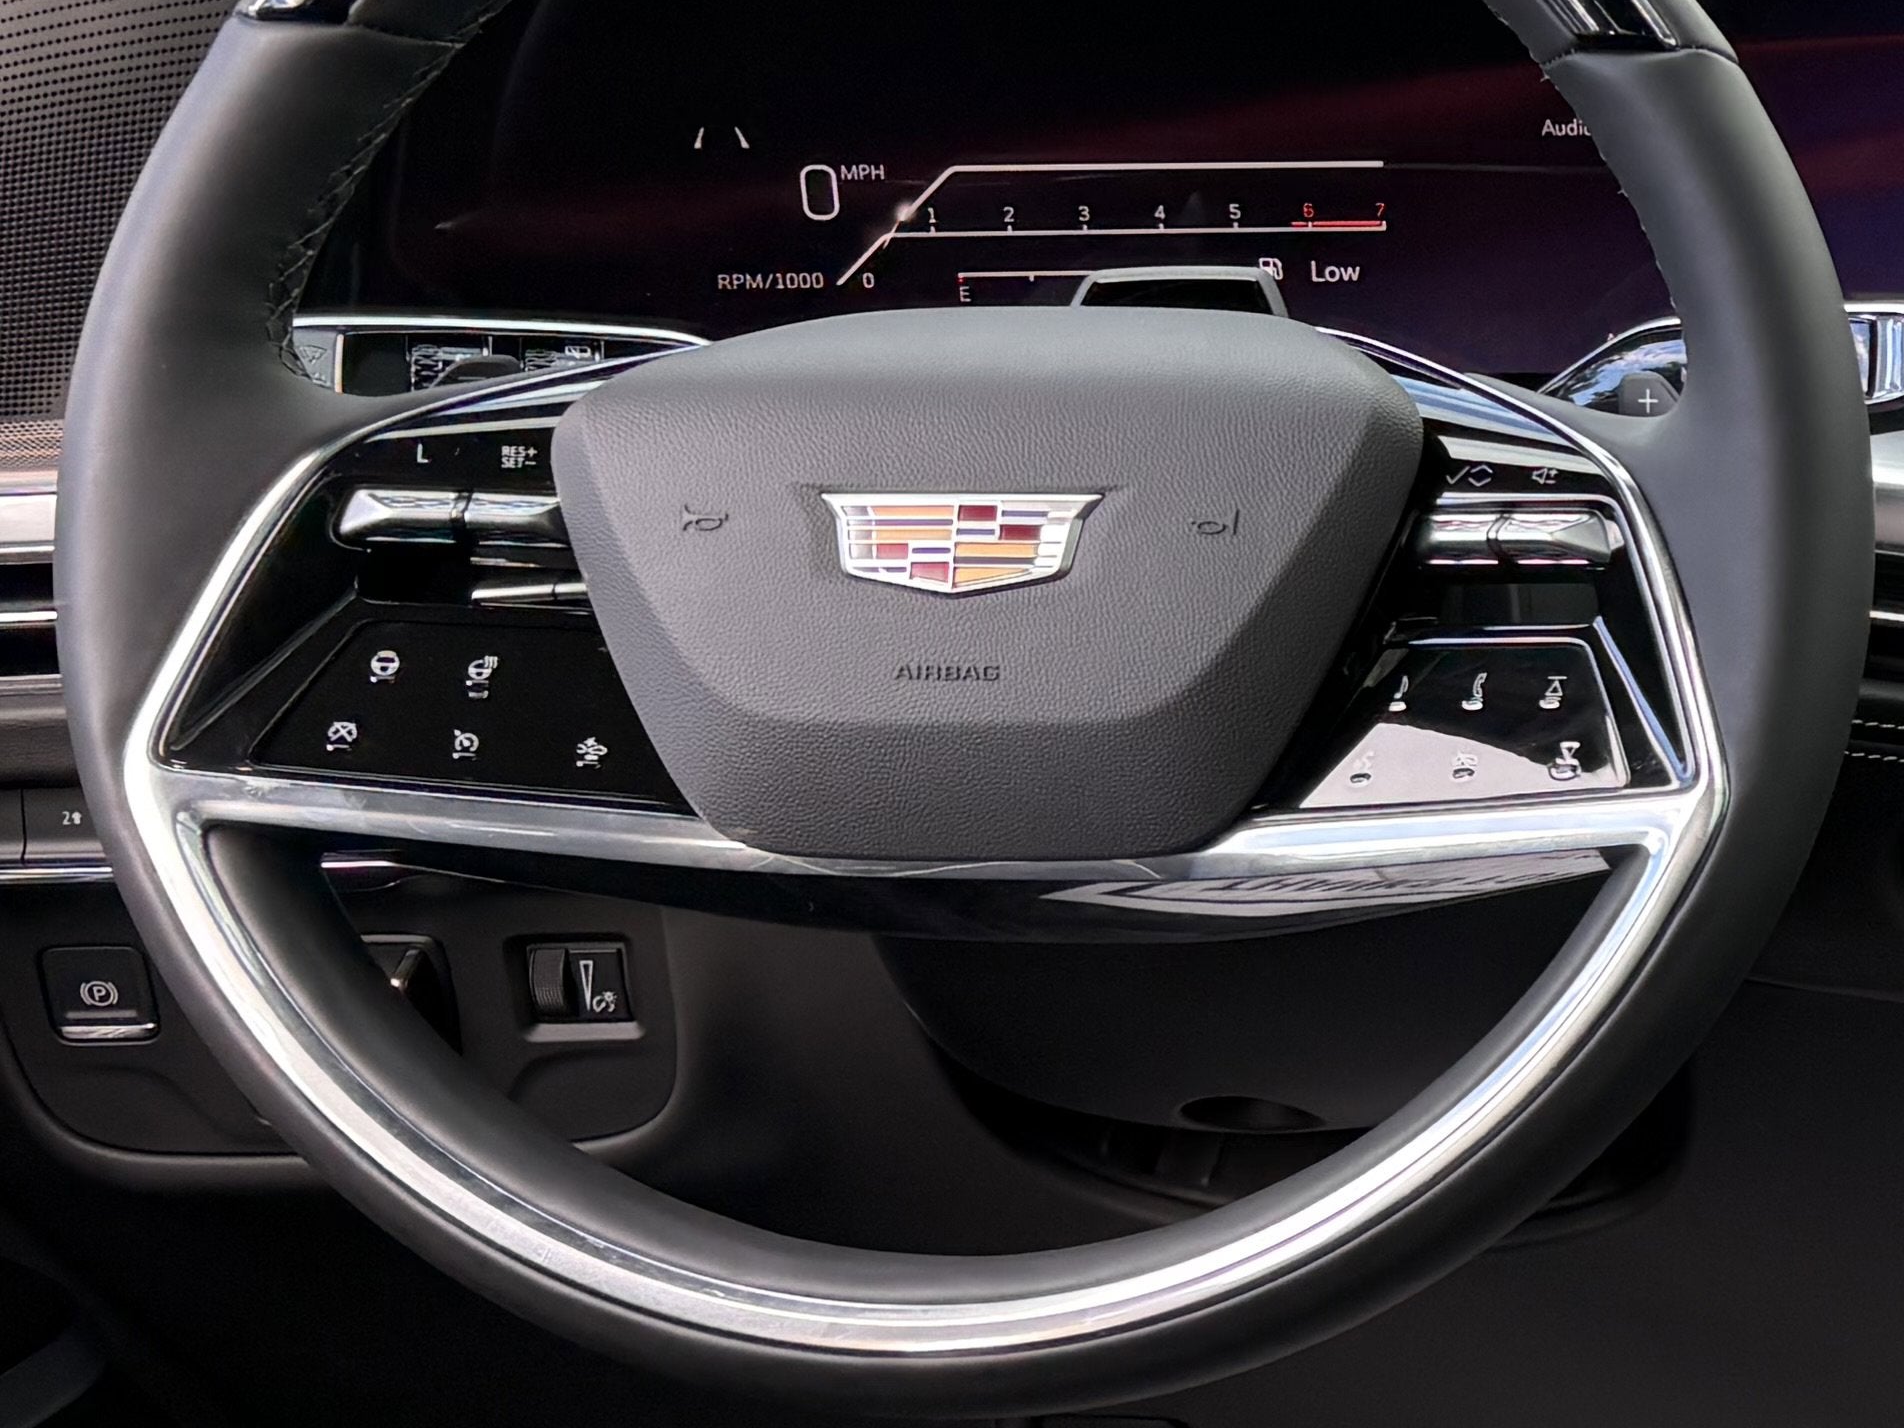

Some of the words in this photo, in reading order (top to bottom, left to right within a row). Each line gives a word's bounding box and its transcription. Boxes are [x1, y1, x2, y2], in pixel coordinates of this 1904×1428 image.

[800, 164, 840, 221] 0
[840, 164, 885, 181] MPH
[926, 206, 937, 224] 1
[1003, 206, 1015, 223] 2
[1078, 205, 1090, 222] 3
[1154, 205, 1166, 221] 4
[1229, 203, 1241, 220] 5
[1303, 203, 1315, 219] 6
[1375, 203, 1386, 219] 7
[716, 272, 825, 290] RPM/1000
[862, 273, 876, 289] 0
[1310, 261, 1361, 283] Low
[958, 286, 972, 303] E
[501, 445, 538, 457] RES+
[894, 664, 1000, 682] AIRBAG
